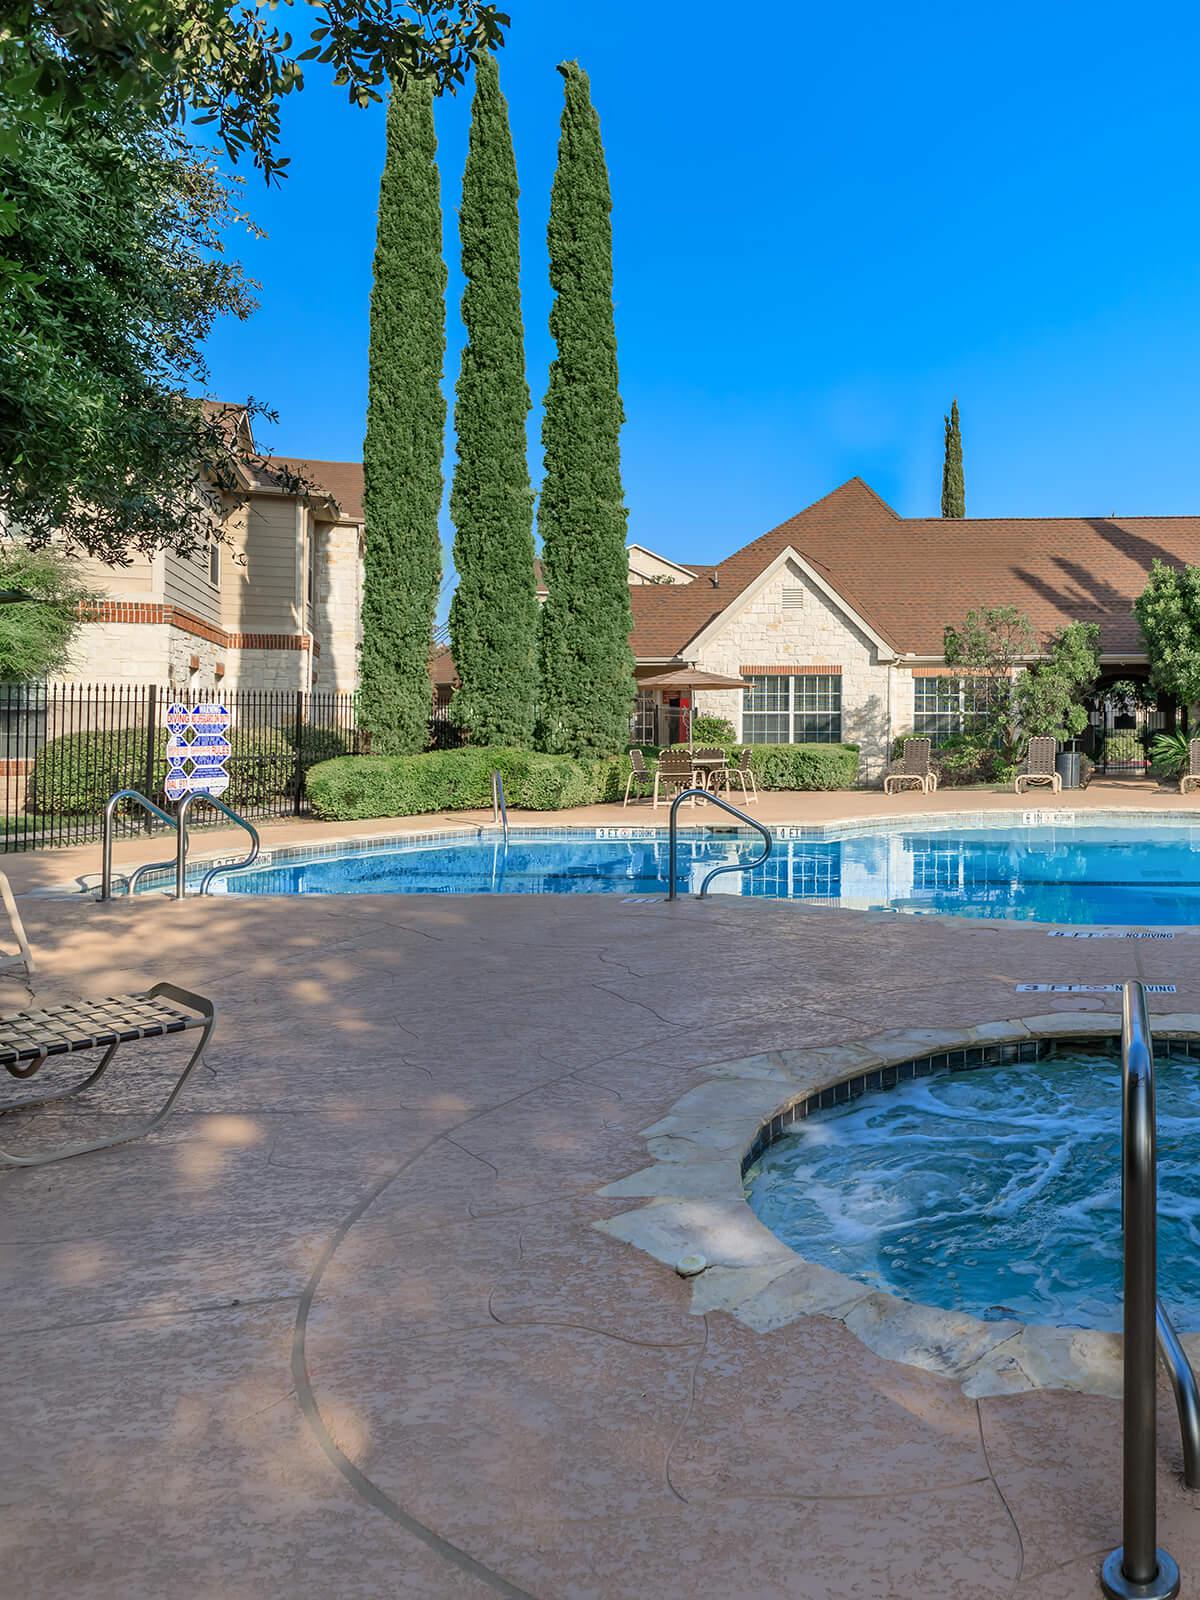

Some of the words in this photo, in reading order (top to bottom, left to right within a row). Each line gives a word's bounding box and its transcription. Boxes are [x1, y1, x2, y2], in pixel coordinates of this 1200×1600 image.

[174, 704, 182, 714] NO
[200, 704, 221, 714] WARNING
[167, 714, 190, 723] DIVING
[211, 745, 230, 755] RULES
